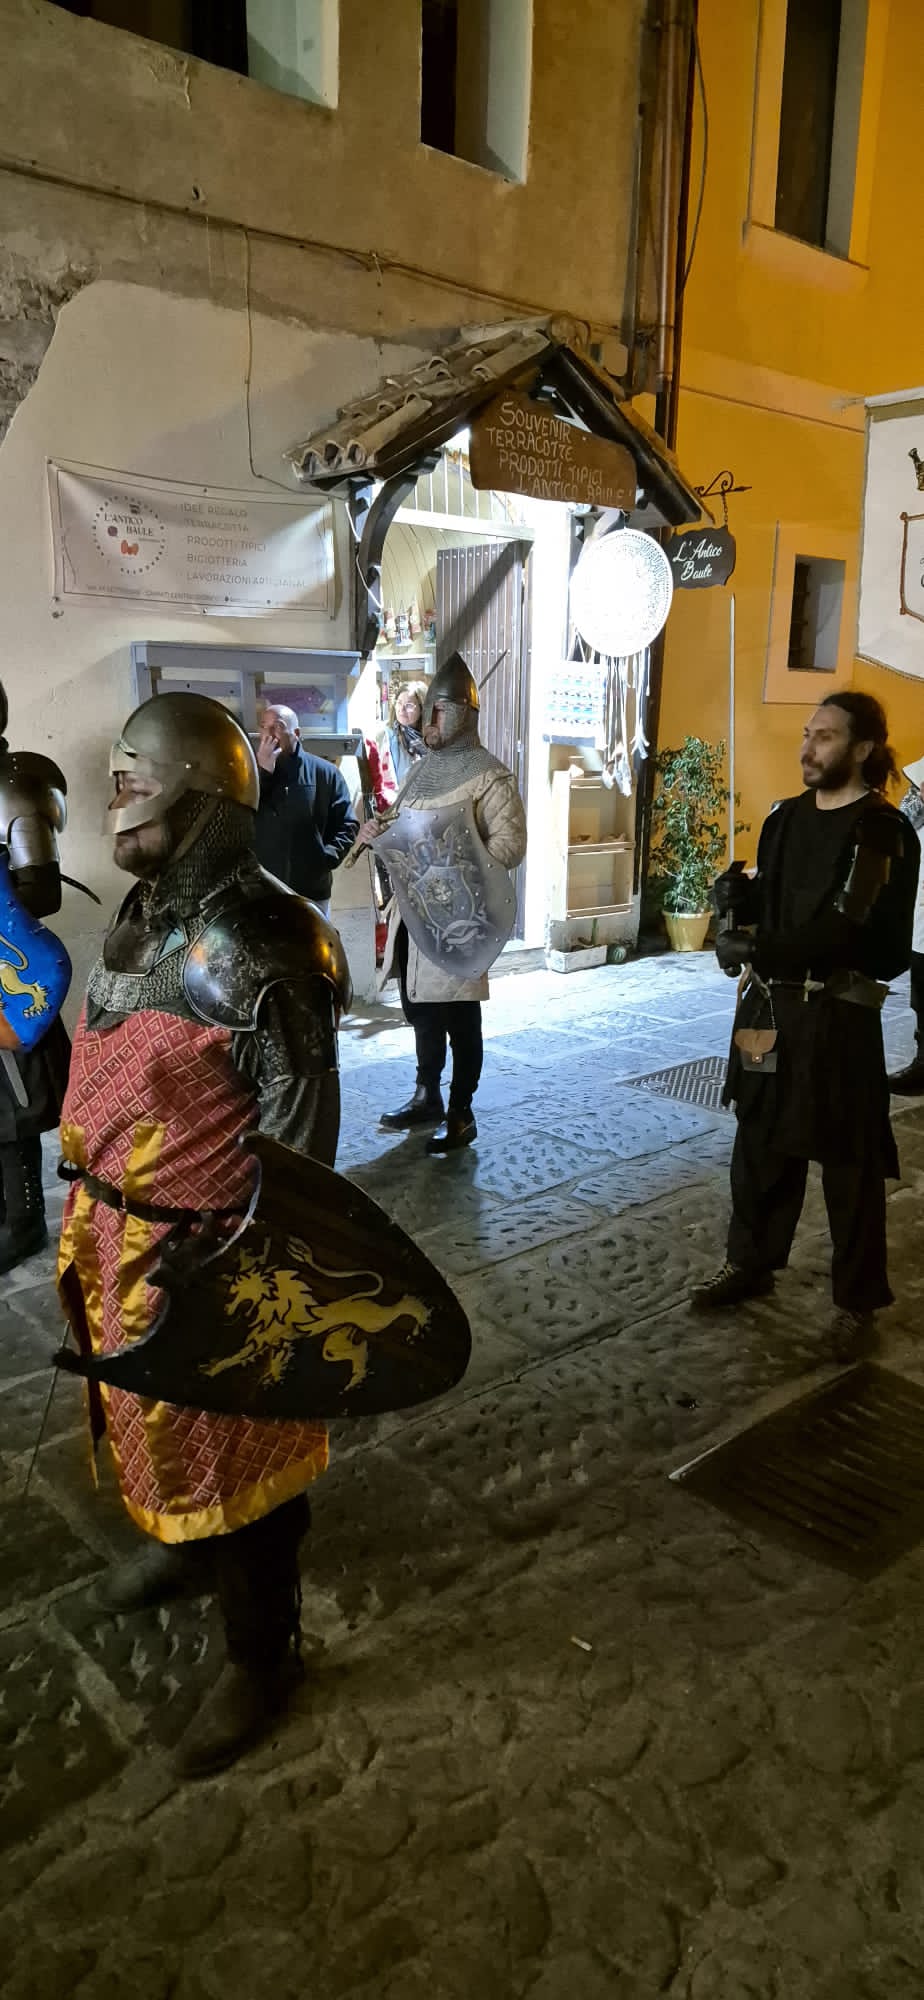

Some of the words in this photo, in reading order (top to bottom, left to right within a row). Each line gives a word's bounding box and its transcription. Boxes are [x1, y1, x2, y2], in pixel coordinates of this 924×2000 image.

[500, 401, 571, 442] SOUVENIR
[485, 427, 573, 460] TERRACOTTE
[498, 450, 563, 478] PRODOTTI
[568, 465, 603, 485] TIPICI
[126, 525, 153, 536] BAULE
[240, 540, 266, 552] TIPICI
[672, 538, 722, 562] L'Antico
[681, 561, 713, 581] Baule
